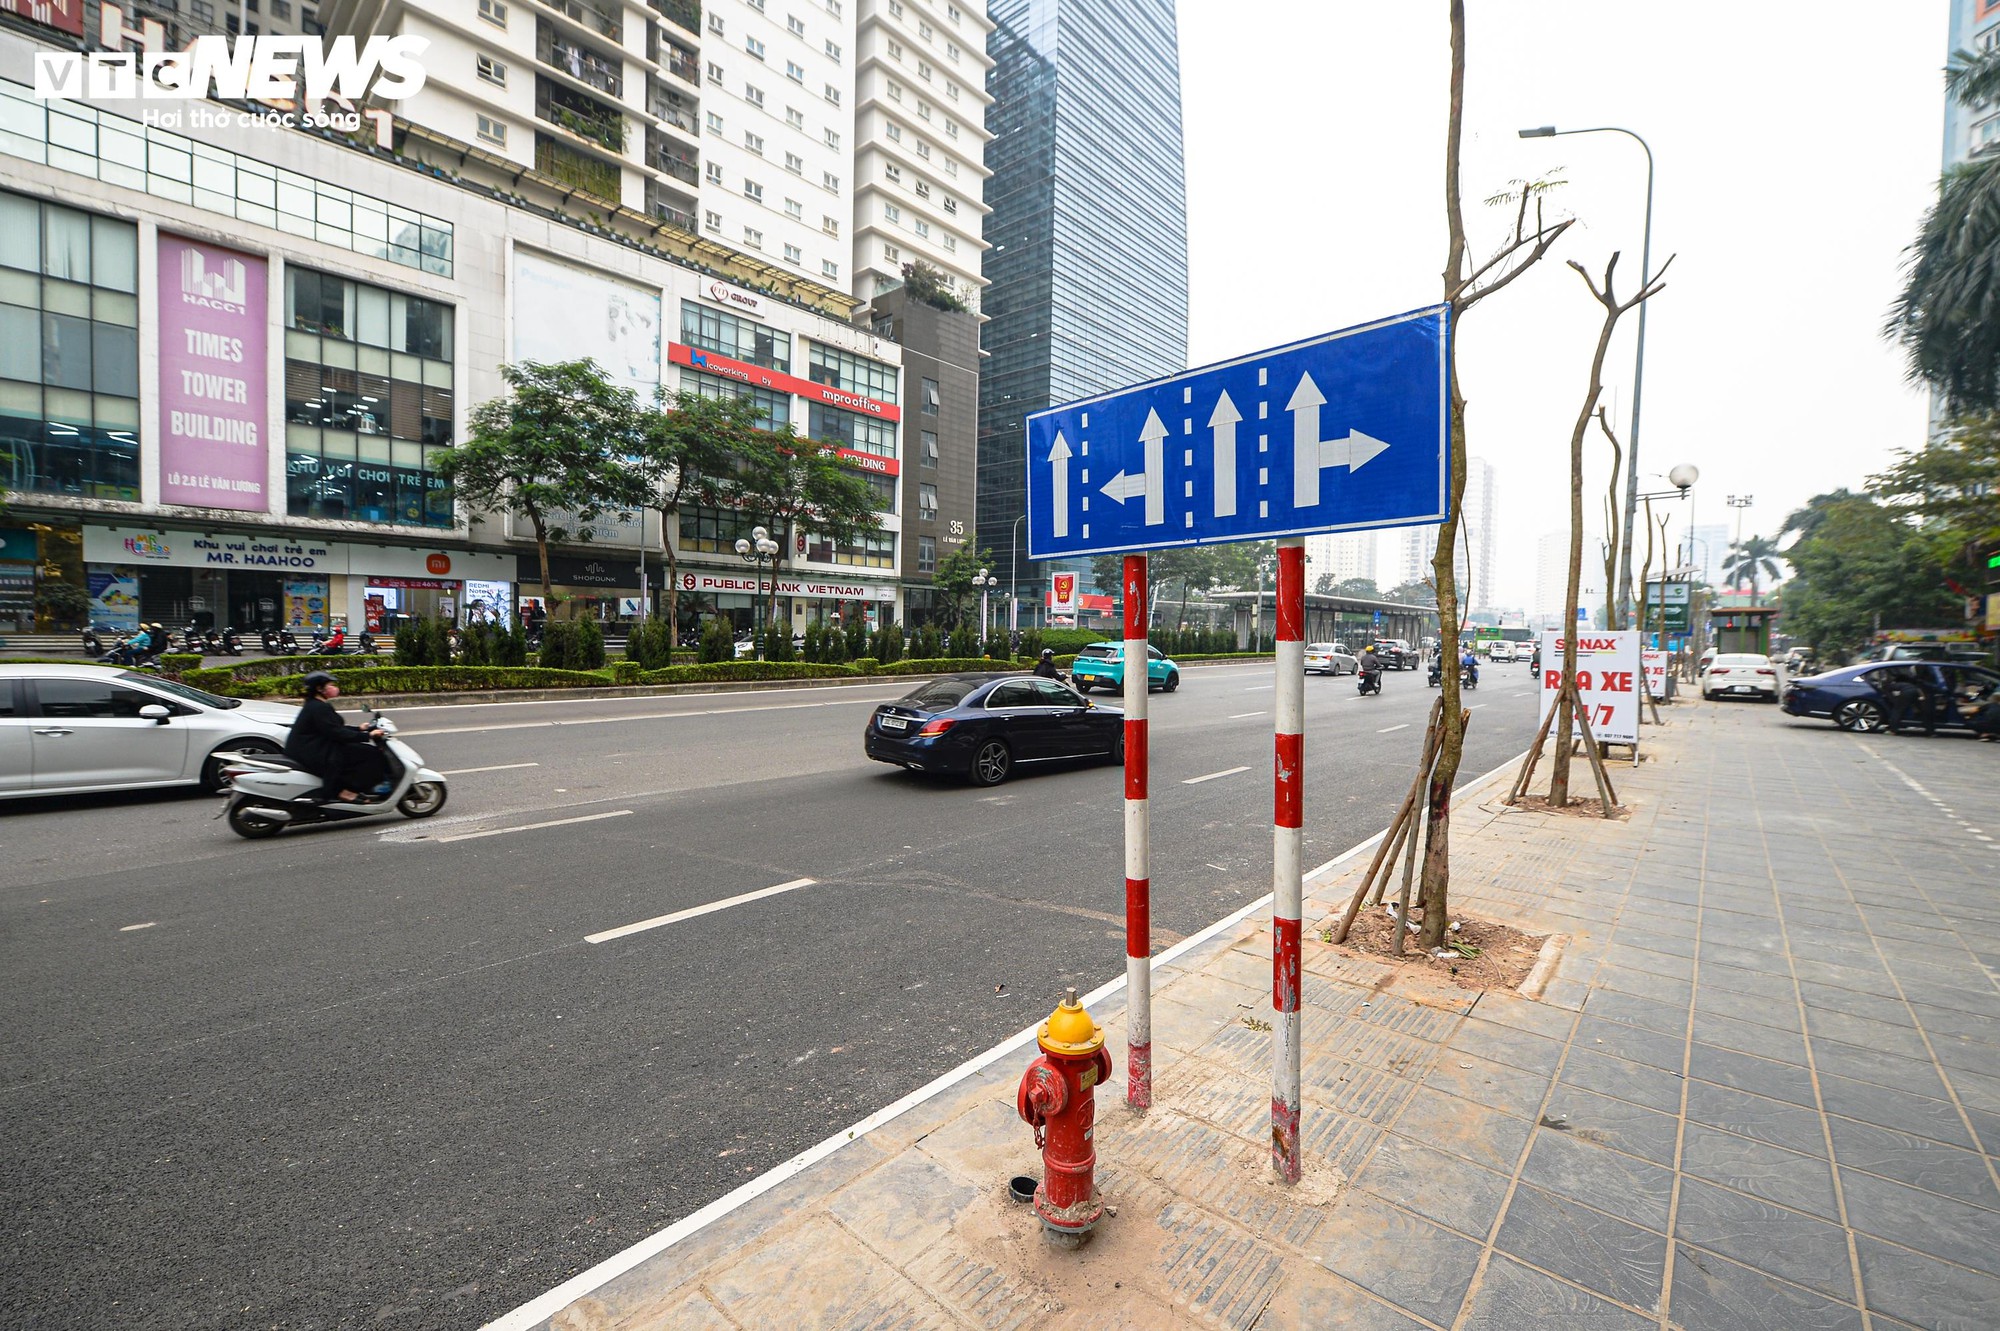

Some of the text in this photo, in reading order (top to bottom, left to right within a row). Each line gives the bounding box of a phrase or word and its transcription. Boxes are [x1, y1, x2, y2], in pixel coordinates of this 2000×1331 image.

[731, 293, 758, 307] GROUP
[184, 328, 243, 363] TIMES
[181, 370, 247, 404] TOWER
[762, 376, 771, 386] by
[170, 410, 257, 446] BUILDING
[198, 475, 210, 488] LÊ
[398, 472, 421, 487] TRẺ
[427, 477, 445, 488] EM
[950, 520, 963, 535] 35
[193, 539, 219, 550] Khu
[226, 542, 245, 551] vui
[251, 543, 278, 553] chơi
[309, 548, 326, 556] em
[207, 552, 314, 567] MR. HAAHOO
[703, 578, 755, 590] PUBLIC
[807, 584, 864, 596] VIETNAM
[1555, 639, 1616, 650] SNAX
[1545, 670, 1633, 692] RA XE
